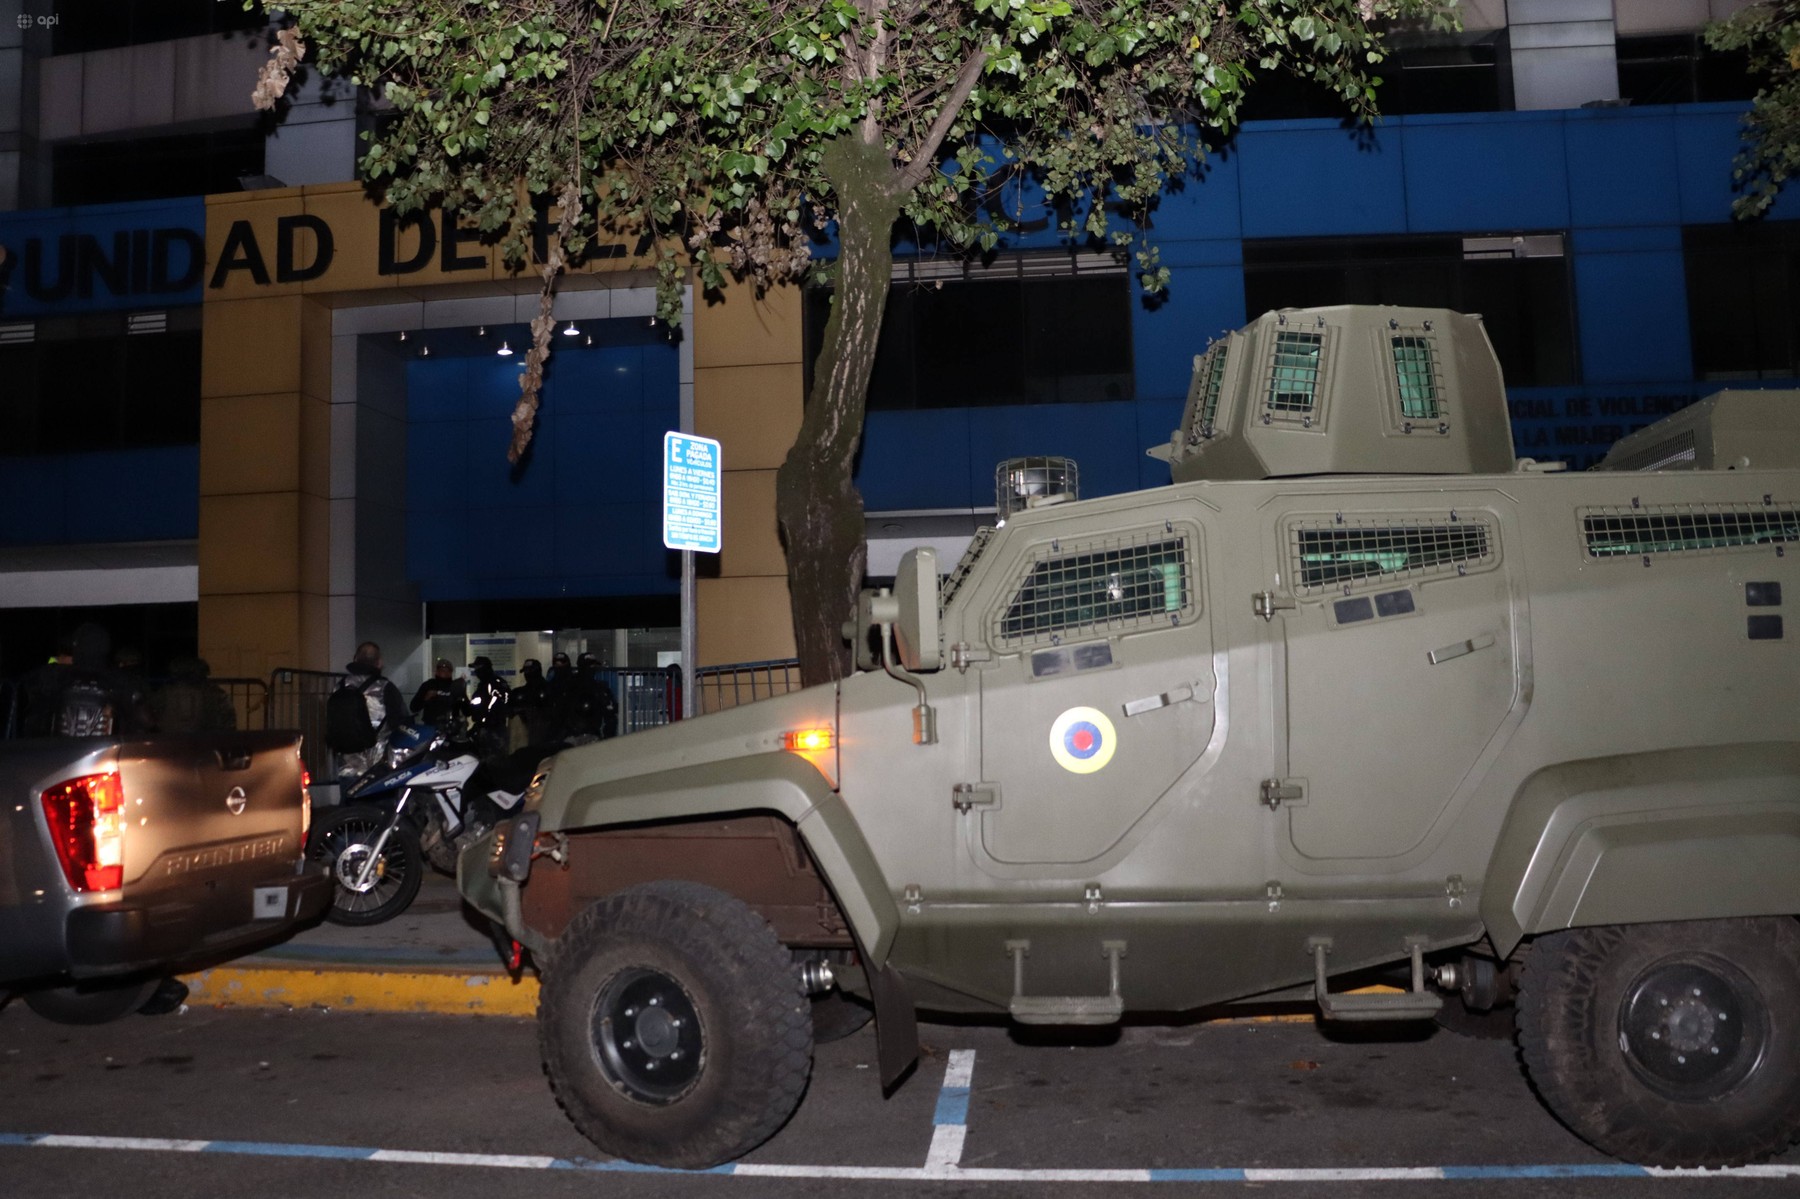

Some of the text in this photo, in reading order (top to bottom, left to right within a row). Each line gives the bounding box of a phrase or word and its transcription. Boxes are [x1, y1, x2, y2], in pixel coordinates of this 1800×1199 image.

[24, 214, 335, 303] UNIDAD
[379, 205, 487, 275] DE
[1566, 397, 1592, 417] DE
[671, 438, 683, 463] E
